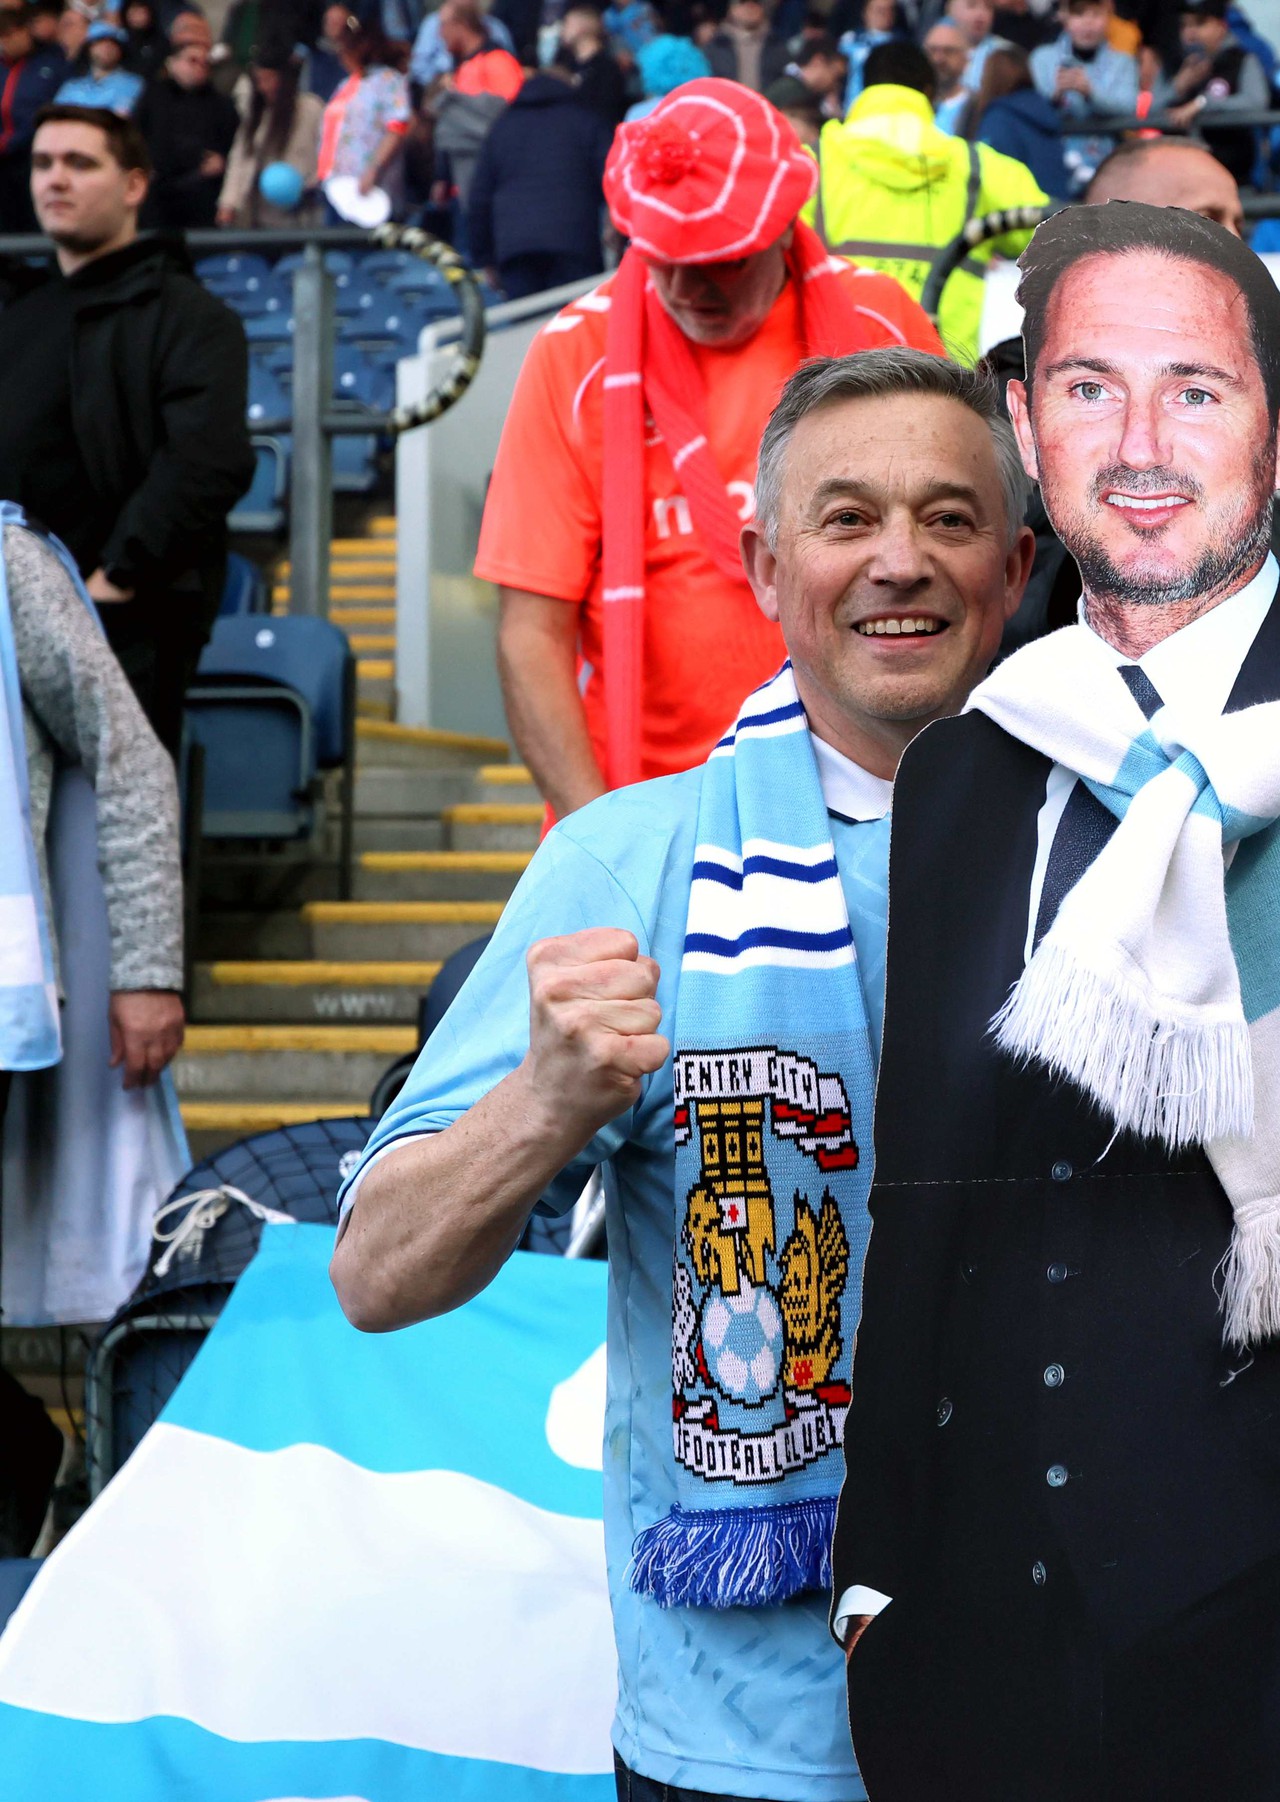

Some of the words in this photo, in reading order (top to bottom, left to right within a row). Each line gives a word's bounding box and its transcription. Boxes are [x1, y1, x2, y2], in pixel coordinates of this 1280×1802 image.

[767, 1056, 812, 1104] CITY
[682, 1429, 784, 1476] FOOTBALL
[784, 1415, 826, 1463] CLUB
